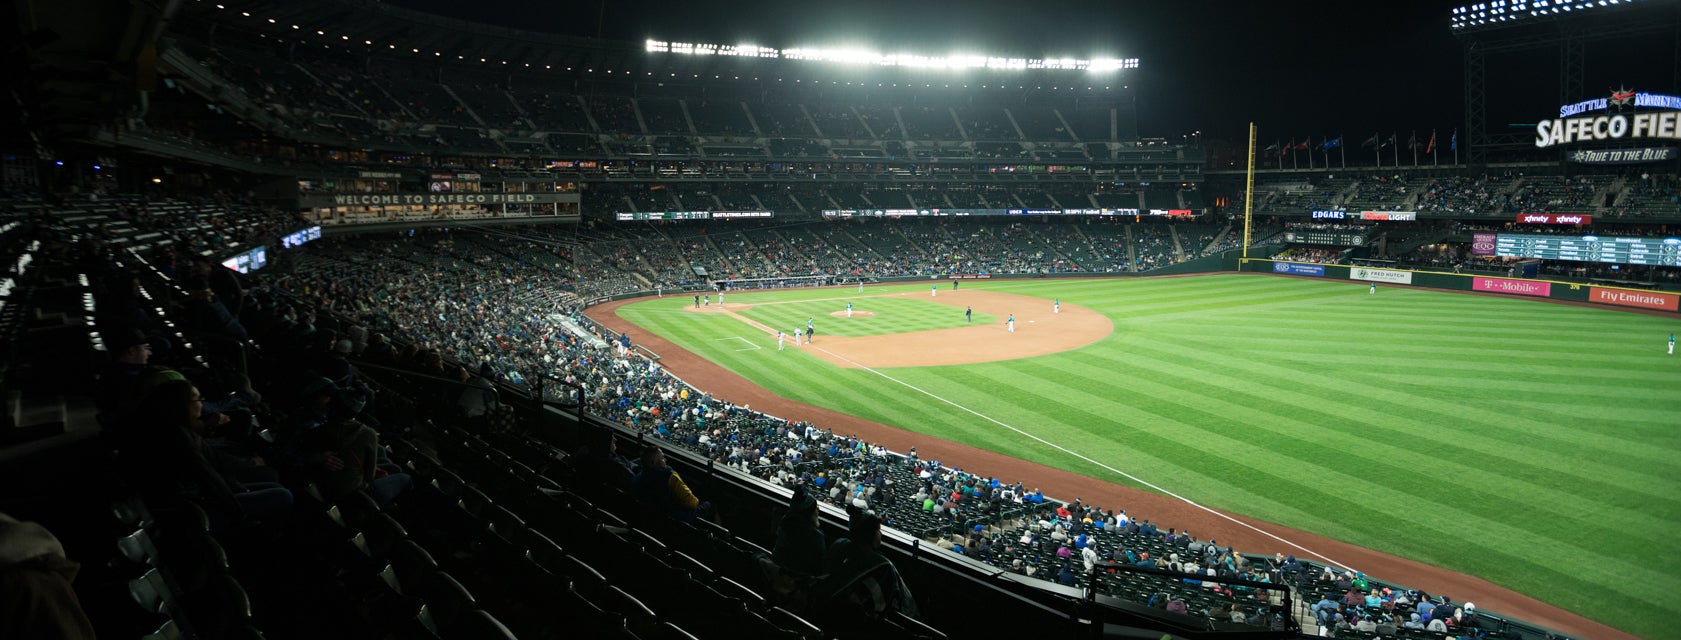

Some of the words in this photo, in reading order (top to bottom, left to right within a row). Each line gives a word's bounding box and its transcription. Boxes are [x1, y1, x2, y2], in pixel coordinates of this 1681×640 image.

[1560, 98, 1607, 118] SEATTLE
[1535, 115, 1628, 148] SAFECO
[1585, 150, 1608, 162] TRUE
[1611, 151, 1621, 161] TO
[1622, 150, 1640, 161] THE
[1642, 148, 1669, 160] BLUE
[335, 195, 399, 205] WELCOME
[404, 195, 423, 204] TO
[429, 194, 486, 203] SAFECO
[492, 194, 535, 203] FIELD
[1524, 214, 1549, 223] xfinity
[1556, 215, 1582, 224] xfinity
[1600, 290, 1618, 302] Fly
[1619, 293, 1665, 306] Emirates
